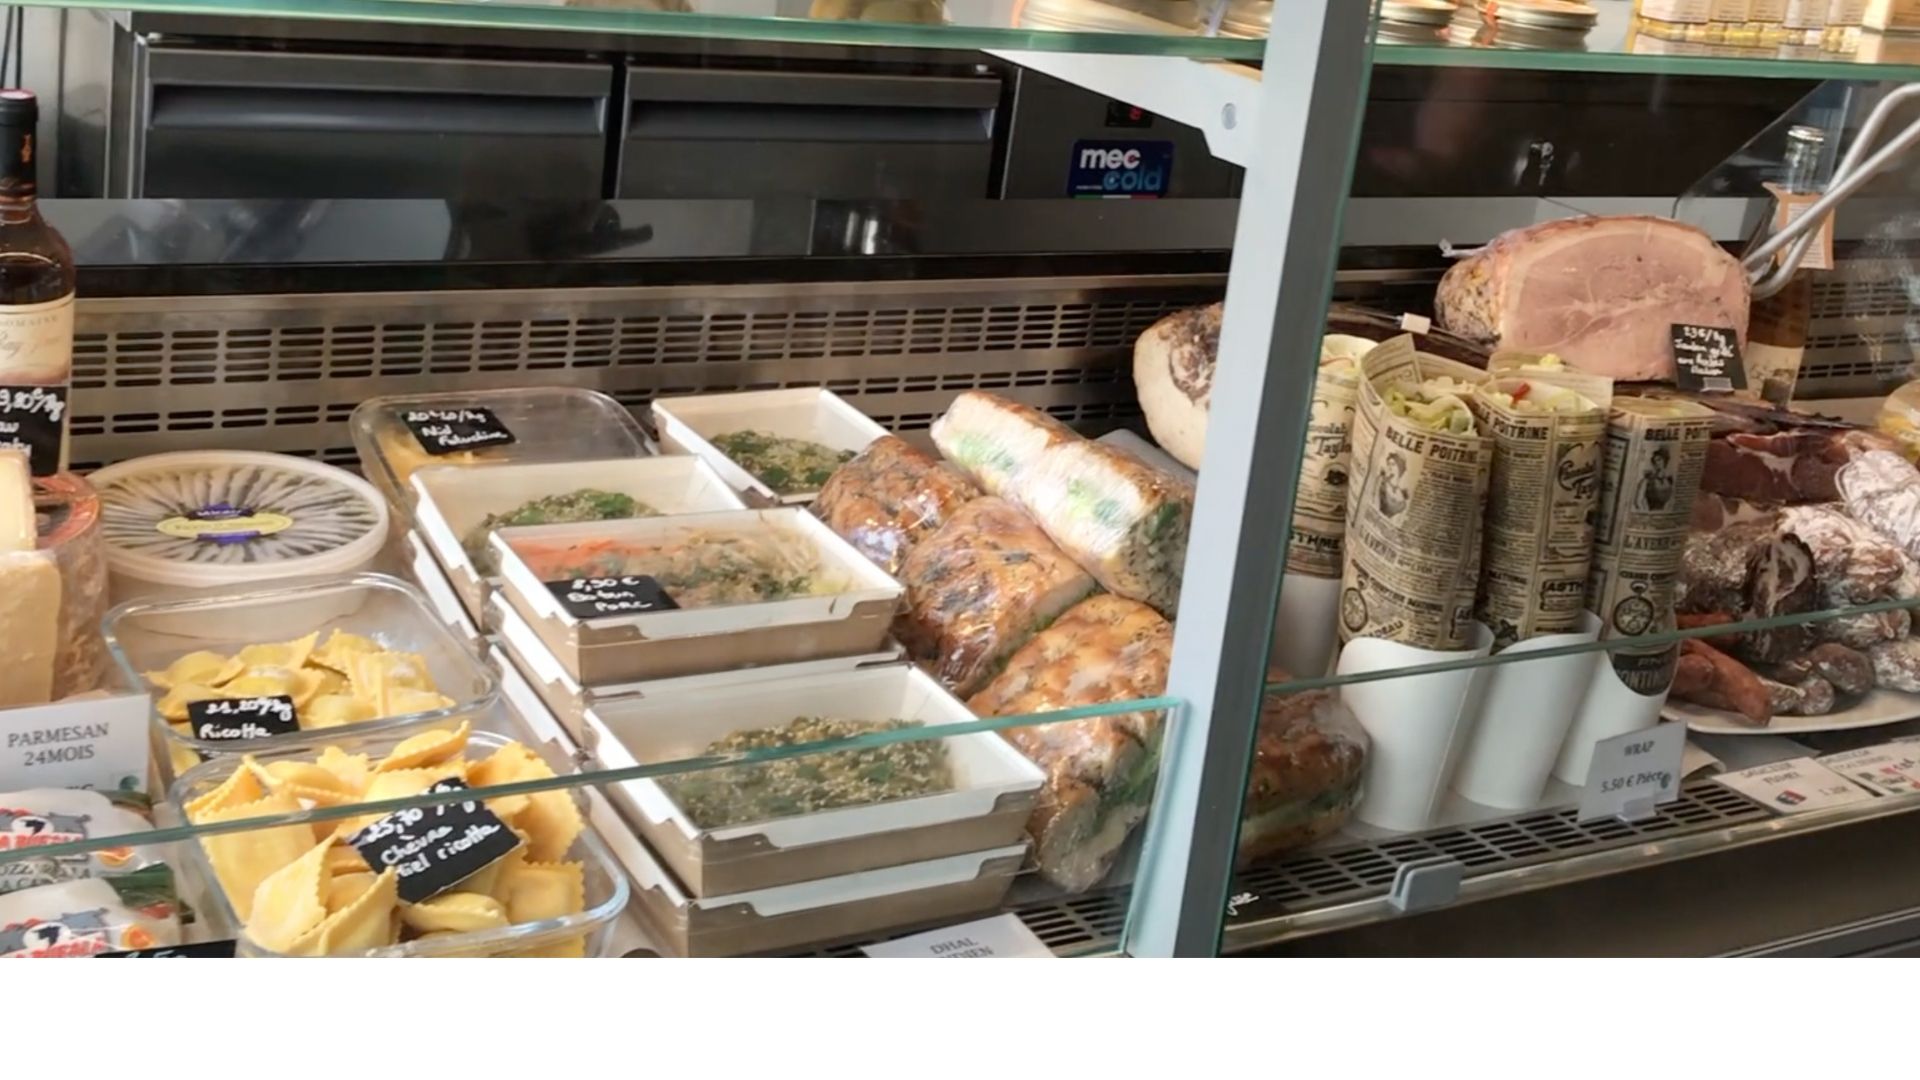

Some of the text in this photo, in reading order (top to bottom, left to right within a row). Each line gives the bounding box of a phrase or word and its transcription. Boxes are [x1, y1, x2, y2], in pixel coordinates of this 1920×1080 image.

[1079, 148, 1141, 170] mec
[1103, 163, 1163, 191] cold
[1386, 426, 1425, 455] BELLE
[1644, 428, 1680, 441] BELLE
[7, 722, 110, 748] PARMESAN
[200, 722, 272, 740] Ricotta
[24, 744, 95, 766] 24MOIS
[930, 937, 978, 955] DHAL
